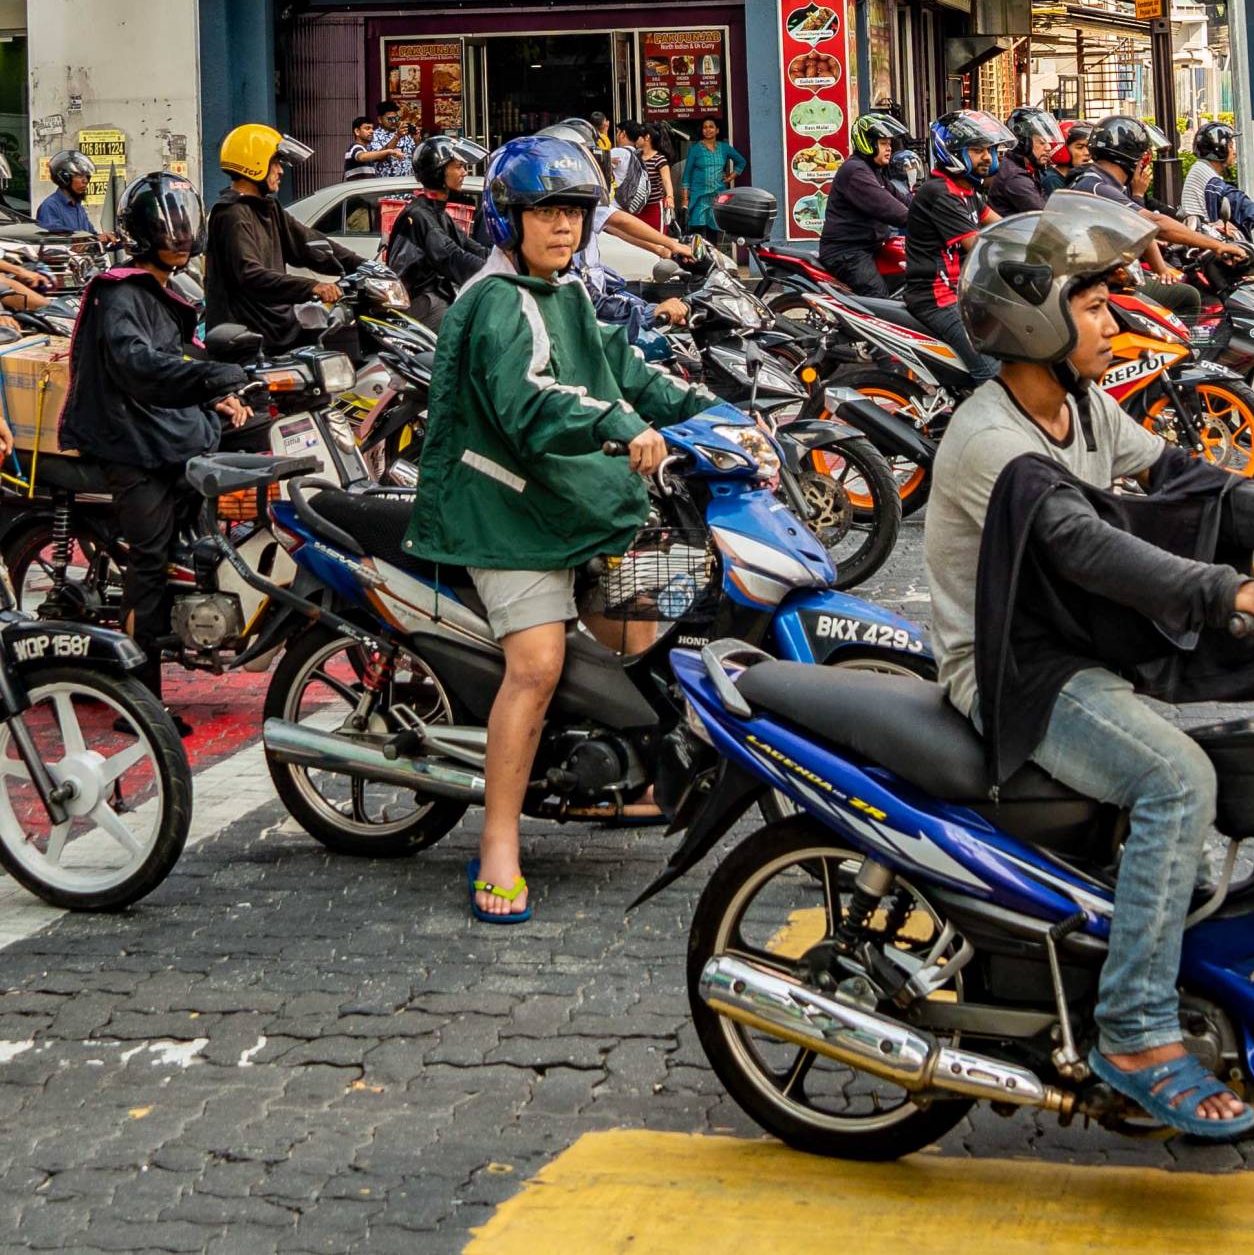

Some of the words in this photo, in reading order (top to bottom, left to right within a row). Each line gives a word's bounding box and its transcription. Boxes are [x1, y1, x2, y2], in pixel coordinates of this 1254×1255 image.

[94, 142, 106, 154] 811
[108, 141, 124, 154] 1224
[1102, 354, 1168, 386] REPSOL
[816, 615, 860, 641] BKX
[52, 634, 91, 657] 1581
[745, 734, 833, 792] LAGENDA
